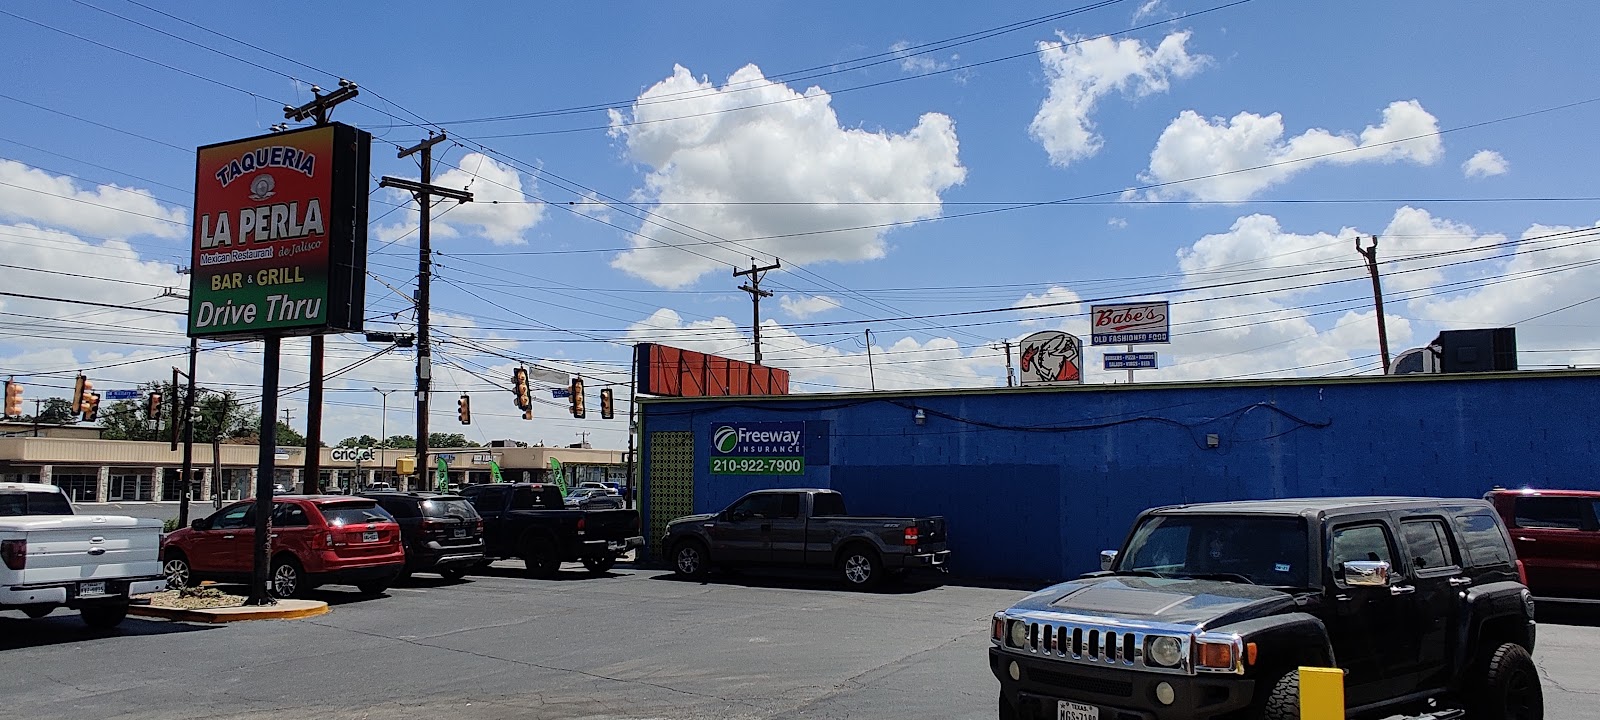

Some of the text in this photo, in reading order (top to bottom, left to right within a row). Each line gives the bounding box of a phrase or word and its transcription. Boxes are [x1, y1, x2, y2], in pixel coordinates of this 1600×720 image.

[215, 146, 315, 188] TAQUERIA
[201, 198, 324, 249] LA PERLA
[200, 240, 322, 266] Mexican Restaurant de Jalisco
[211, 266, 305, 291] BAR & GRILL
[196, 294, 322, 328] Drive Thru
[1096, 307, 1164, 328] Babe's
[1109, 334, 1147, 342] FASHIONED
[1148, 333, 1167, 341] FOOD
[738, 427, 801, 446] Freeway
[332, 447, 375, 461] cricket
[713, 459, 801, 472] 210-922-7900
